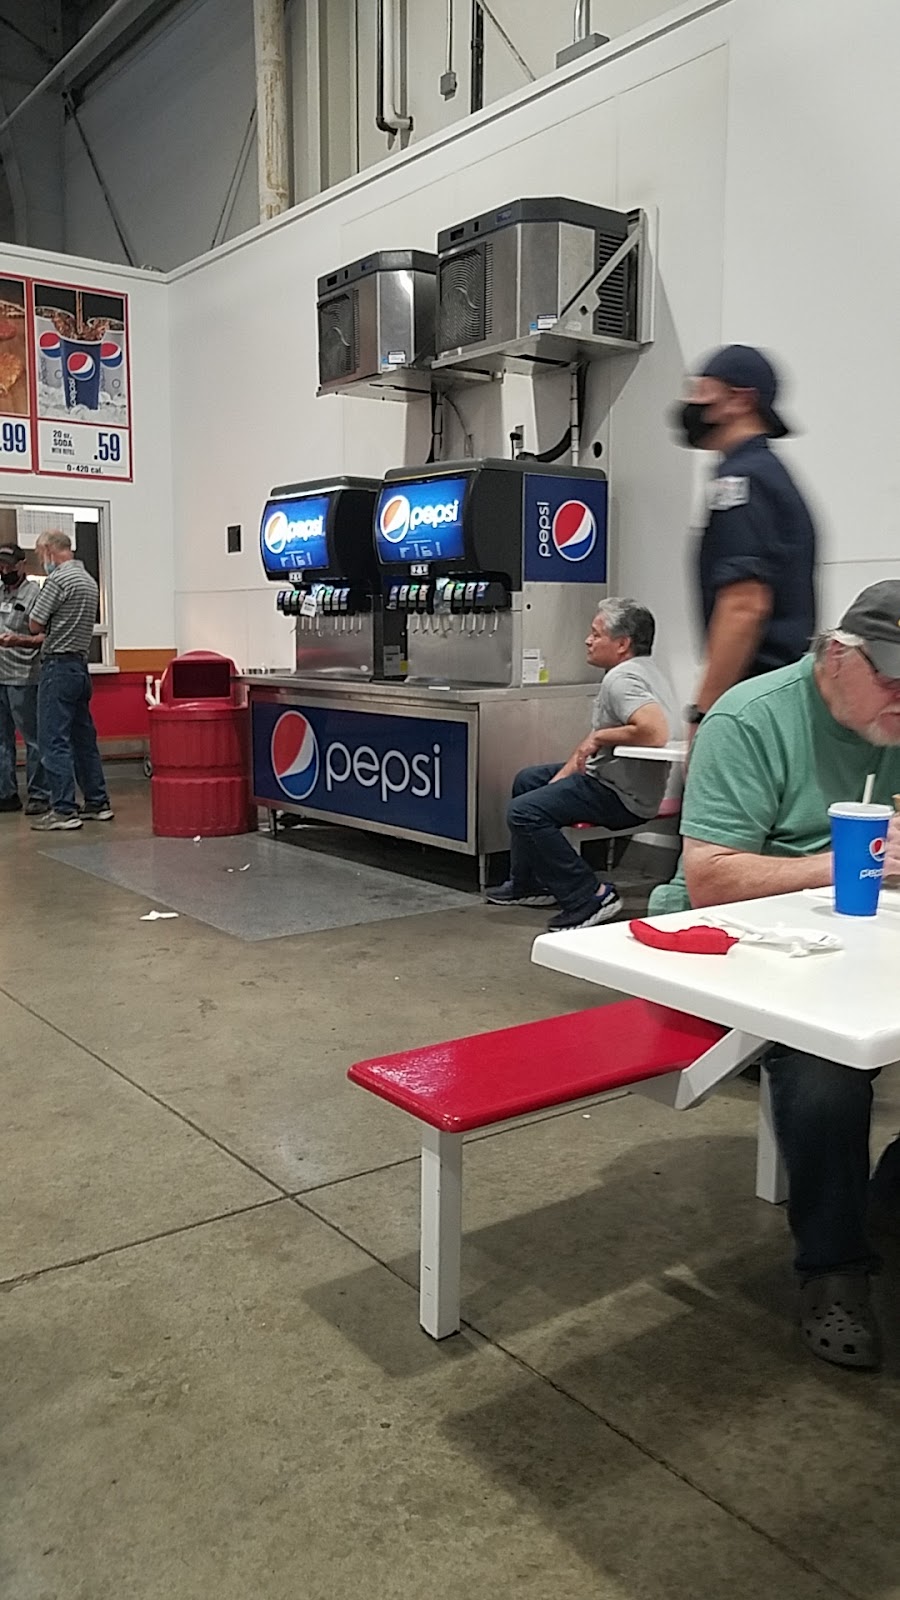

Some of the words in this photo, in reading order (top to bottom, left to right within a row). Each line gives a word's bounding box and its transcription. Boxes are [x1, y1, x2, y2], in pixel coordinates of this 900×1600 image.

[53, 430, 62, 438] 20
[53, 439, 73, 447] SODA
[94, 432, 121, 462] .59
[90, 467, 104, 475] cal.
[286, 515, 324, 543] pepsi
[410, 499, 459, 531] pepsi
[537, 501, 551, 558] pepsi
[326, 742, 441, 802] pepsi
